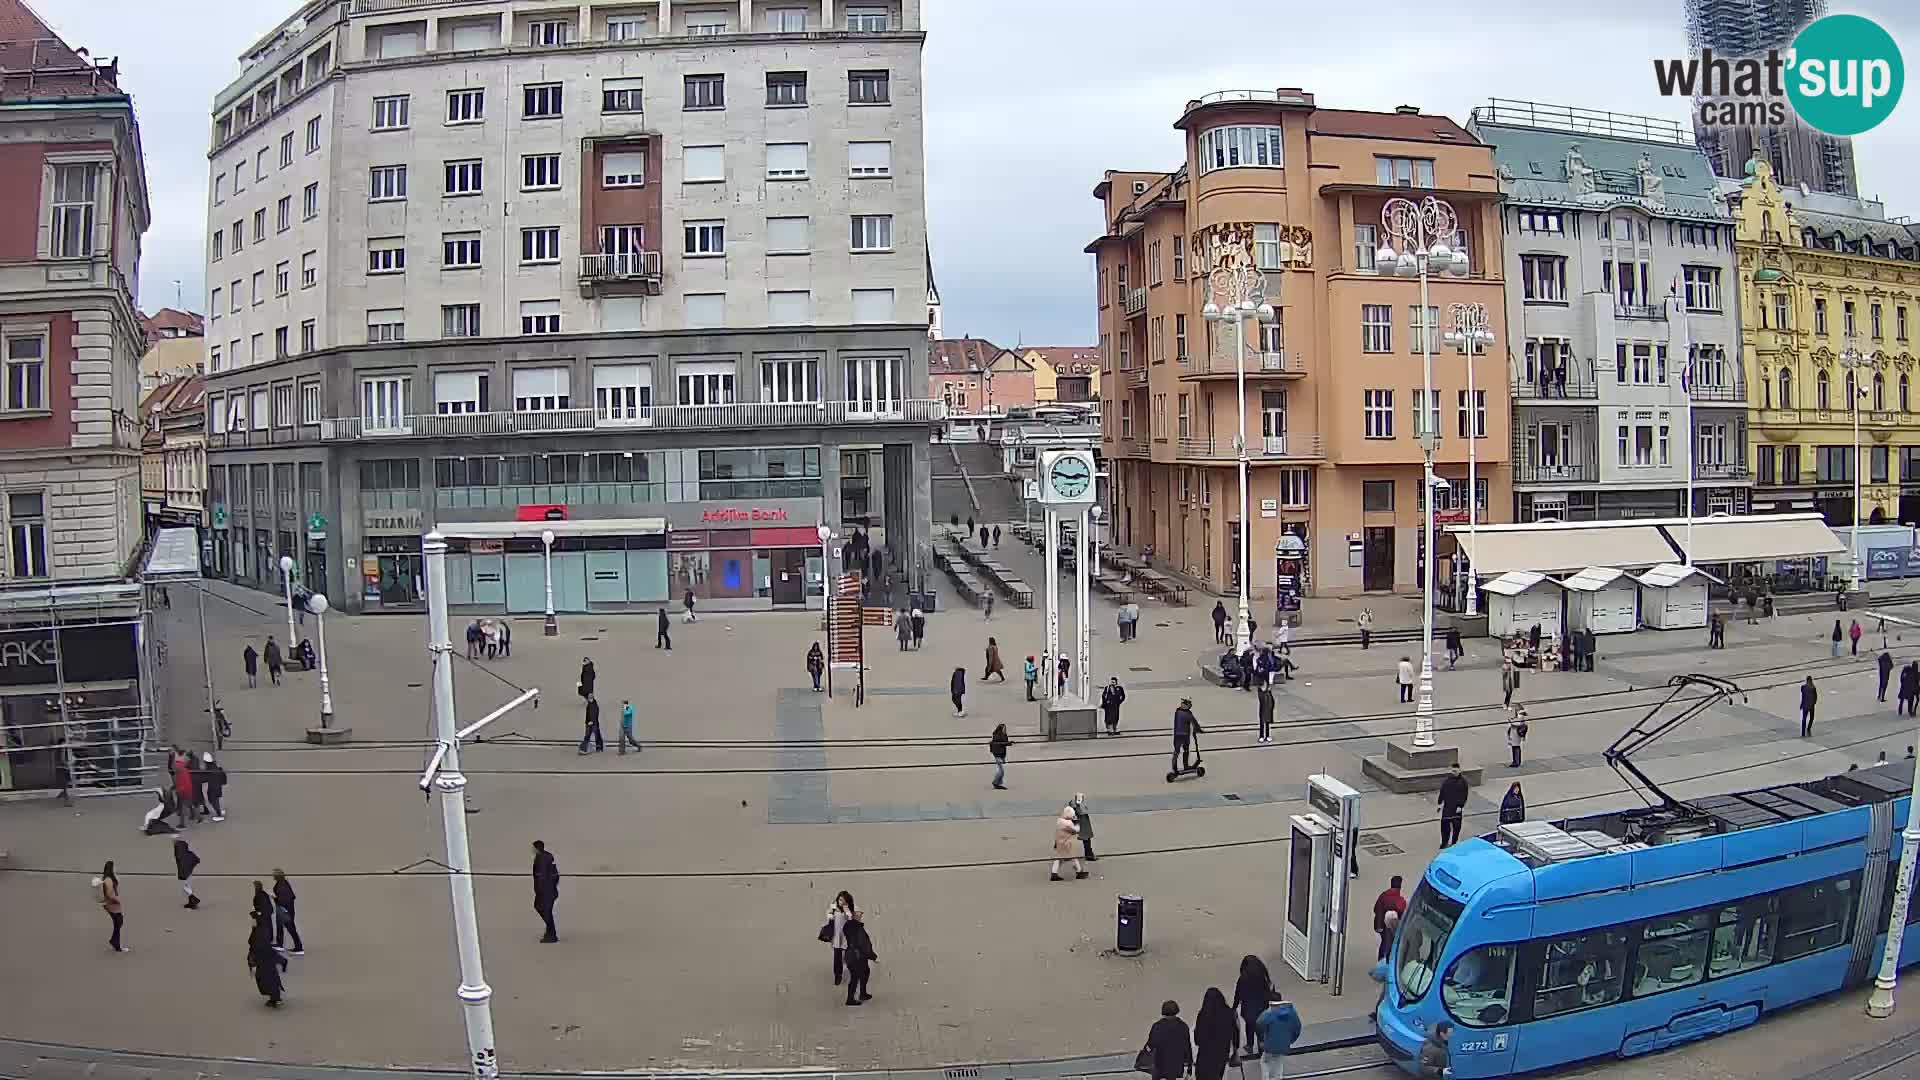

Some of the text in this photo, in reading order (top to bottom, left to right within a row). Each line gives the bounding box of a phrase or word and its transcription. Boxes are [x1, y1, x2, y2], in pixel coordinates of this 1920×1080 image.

[752, 506, 788, 521] Bank
[0, 640, 58, 667] AKS
[1461, 1040, 1488, 1052] 2273
